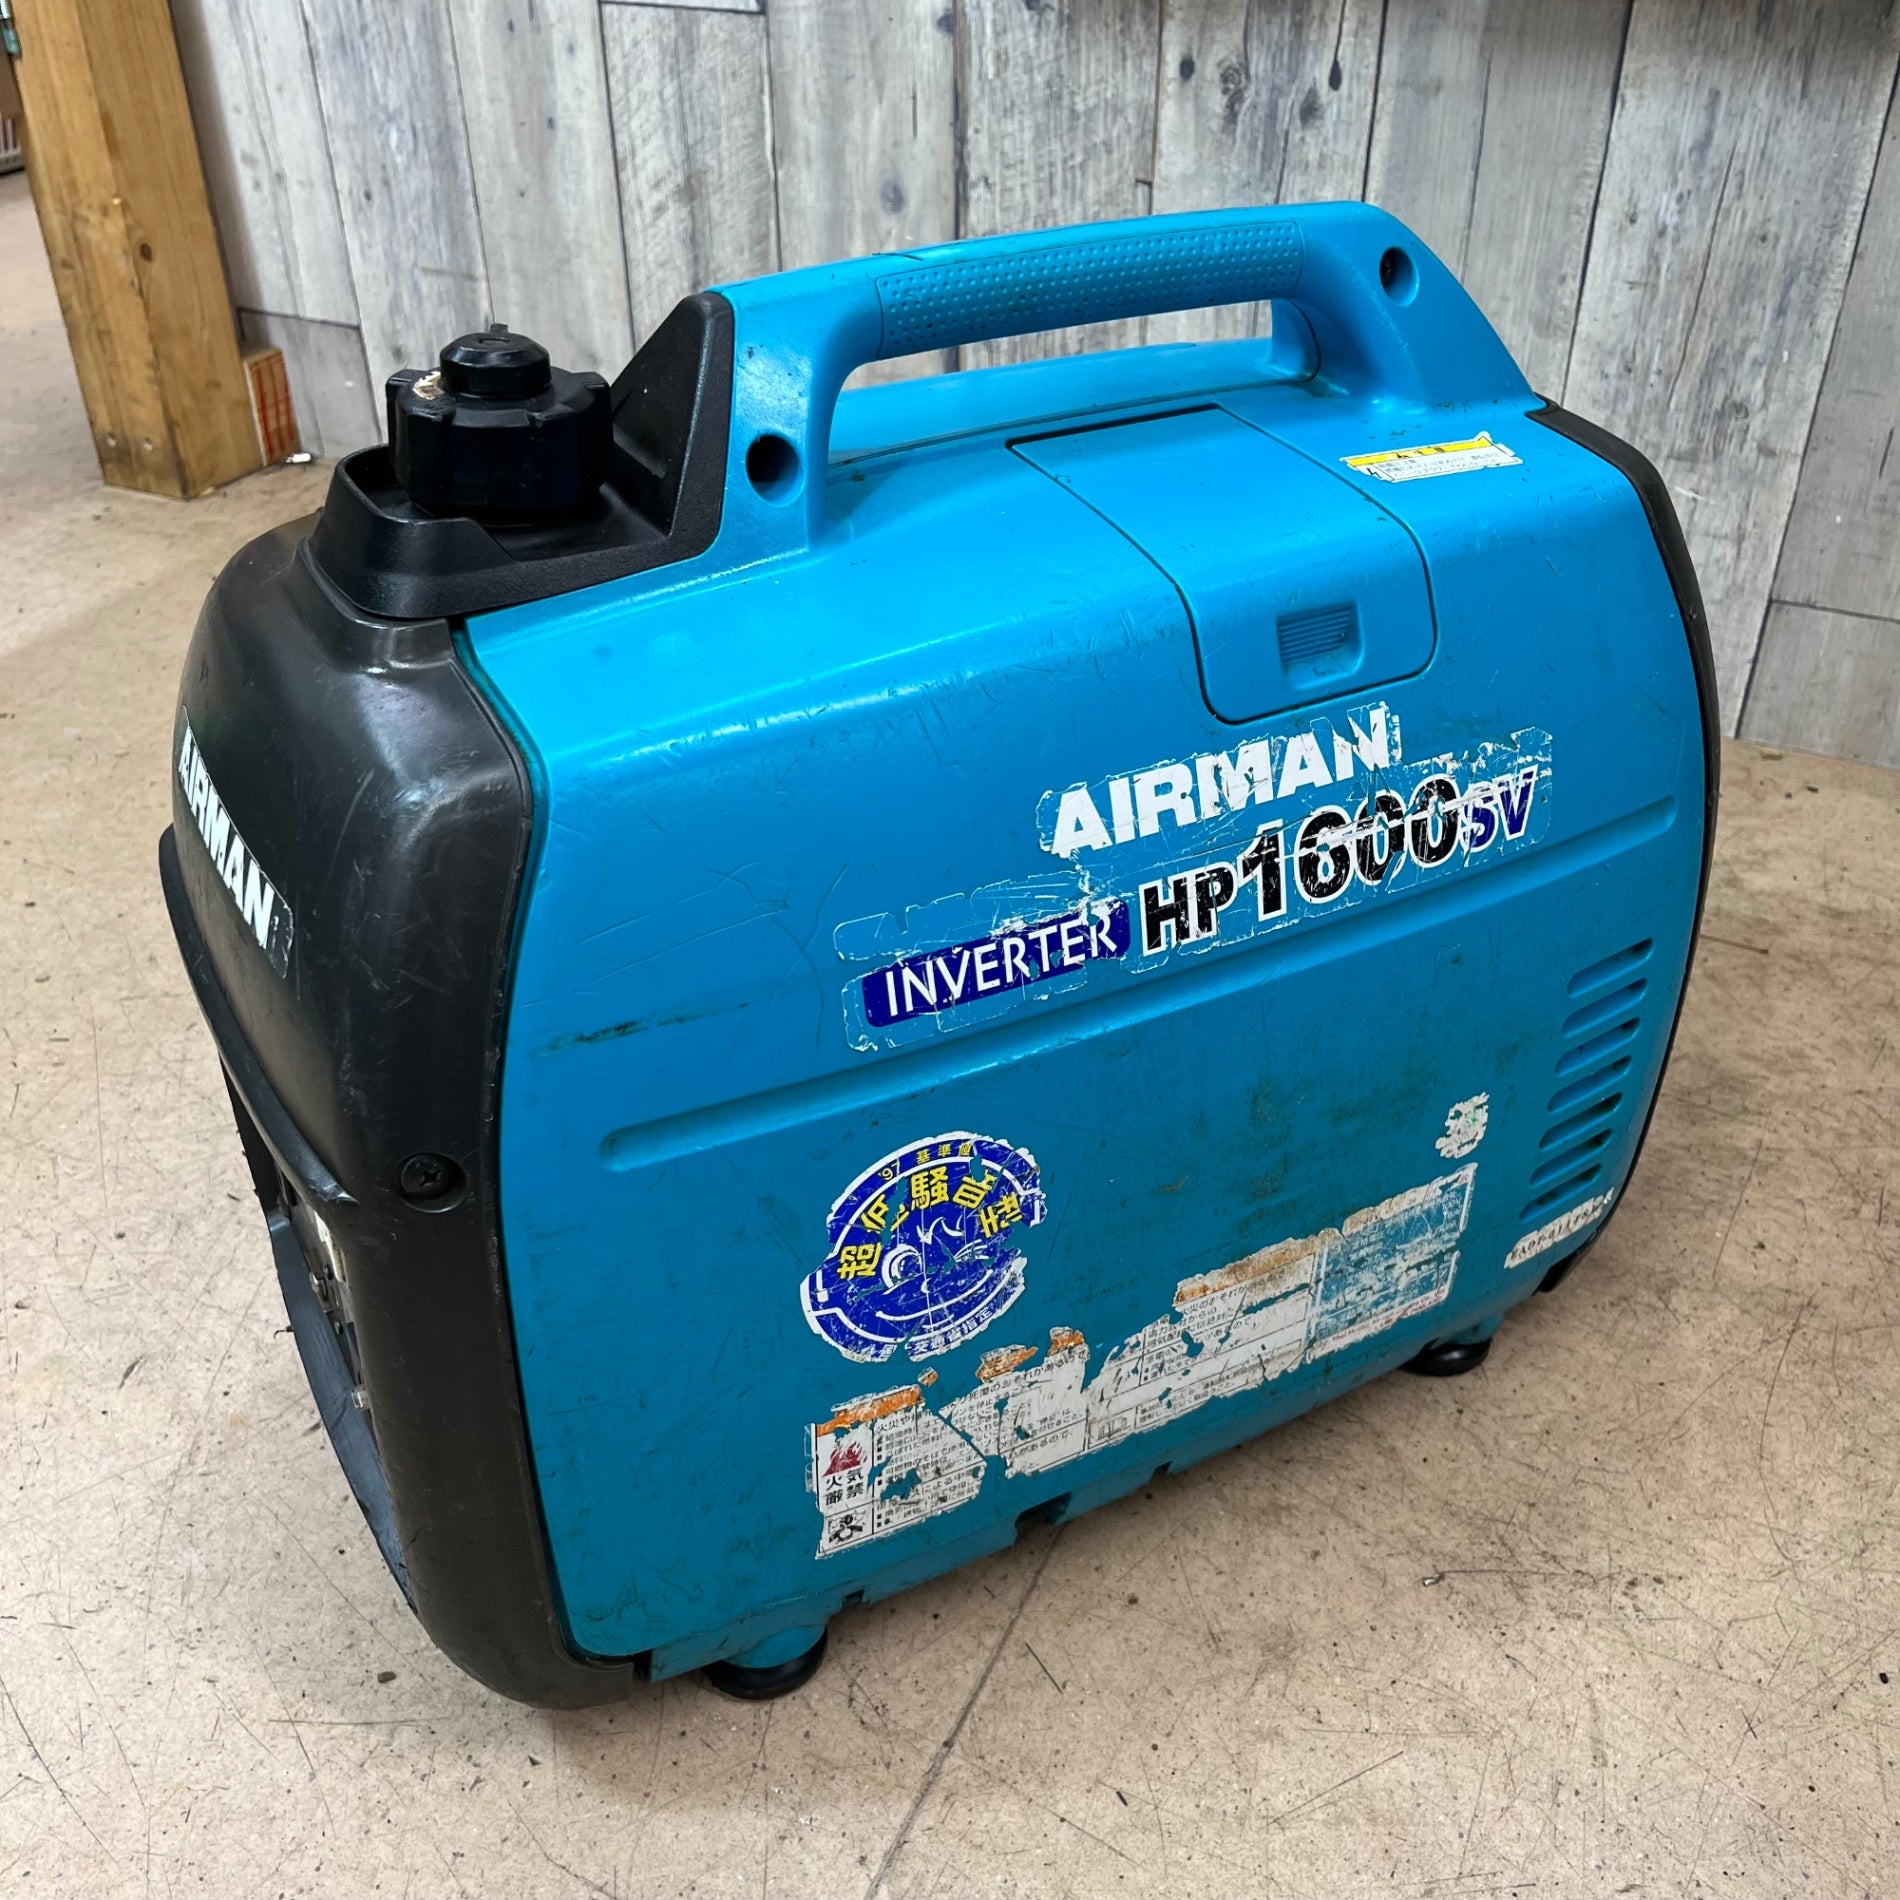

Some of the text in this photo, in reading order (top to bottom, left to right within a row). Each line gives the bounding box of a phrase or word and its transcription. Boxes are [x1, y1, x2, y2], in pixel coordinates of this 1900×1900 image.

[178, 725, 275, 950] AIRMAN
[1051, 706, 1392, 856] AIRMAN
[885, 905, 1118, 1017] INVERTER
